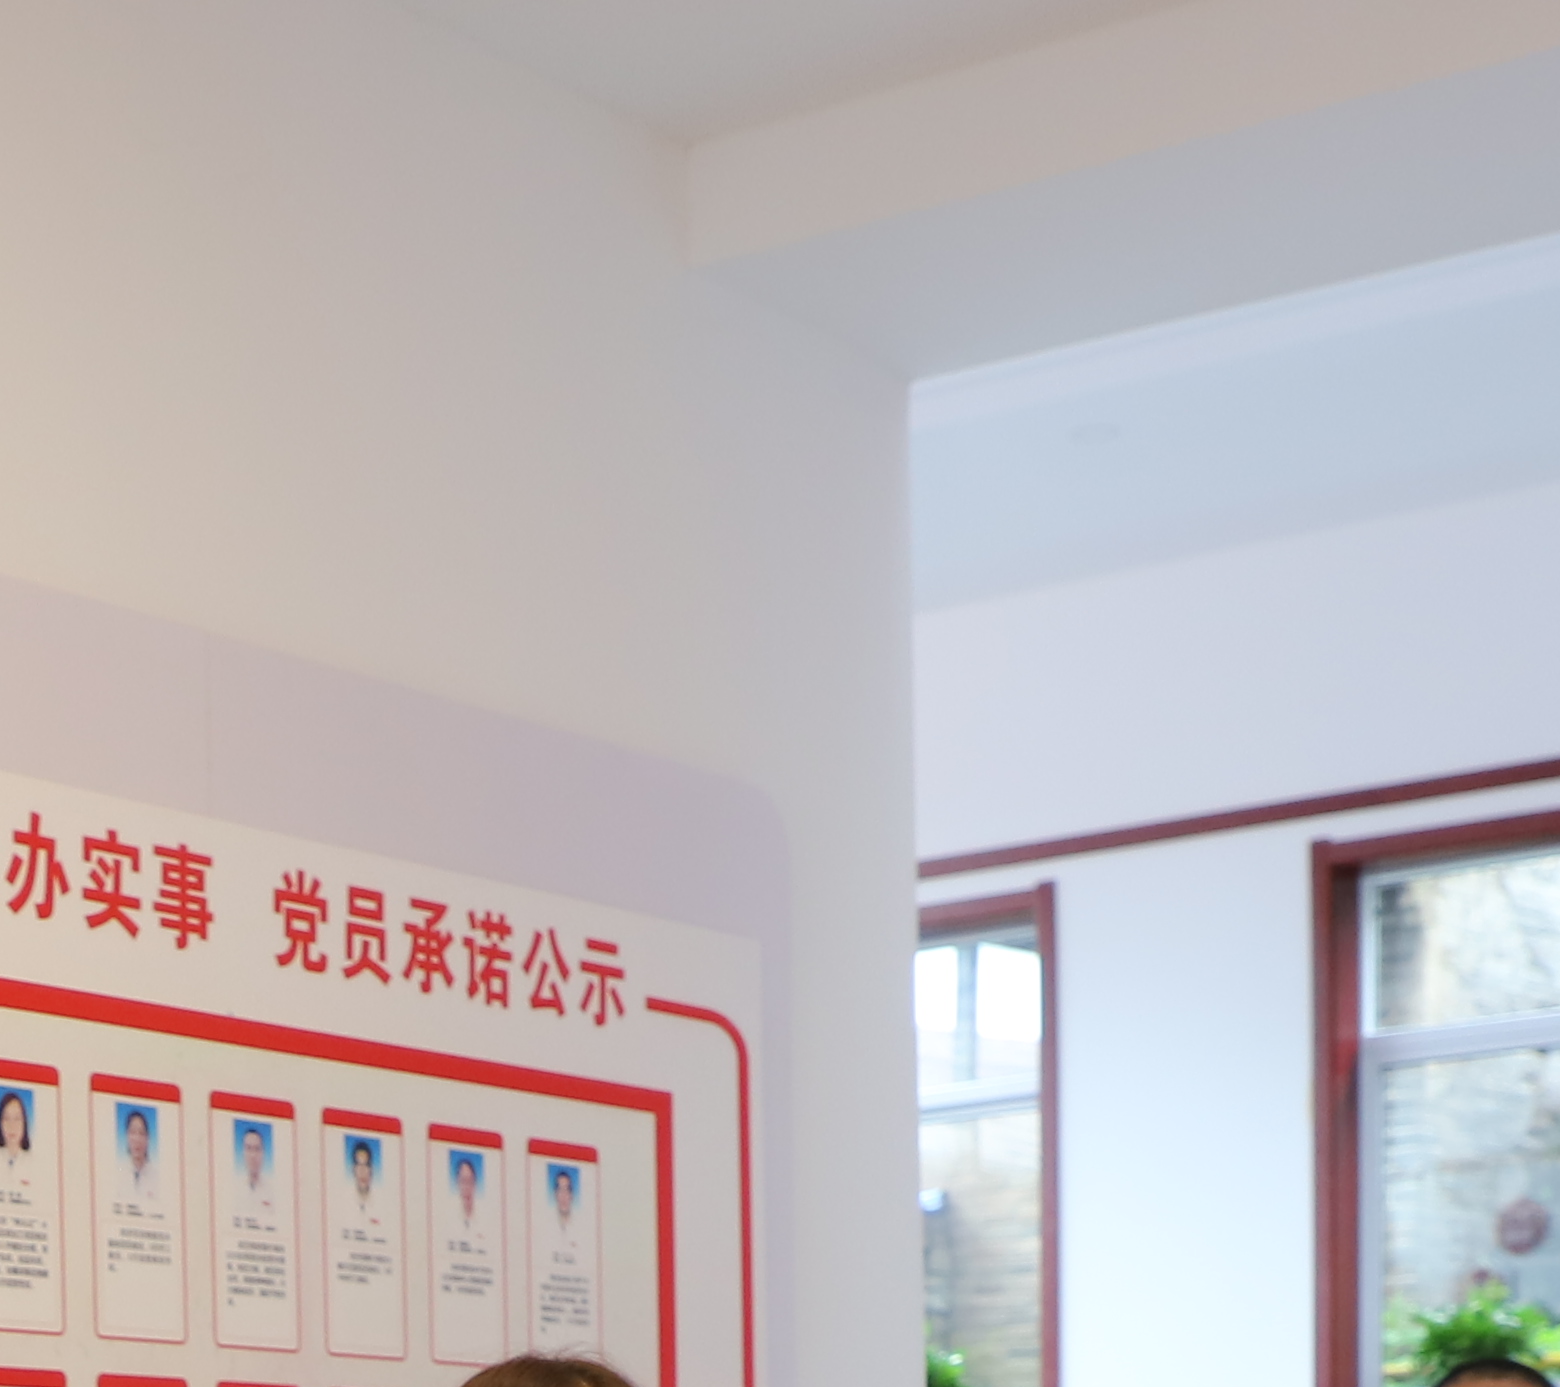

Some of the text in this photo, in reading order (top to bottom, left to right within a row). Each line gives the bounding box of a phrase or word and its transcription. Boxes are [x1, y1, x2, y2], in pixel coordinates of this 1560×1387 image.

[273, 868, 628, 1028] 党员承诺公示
